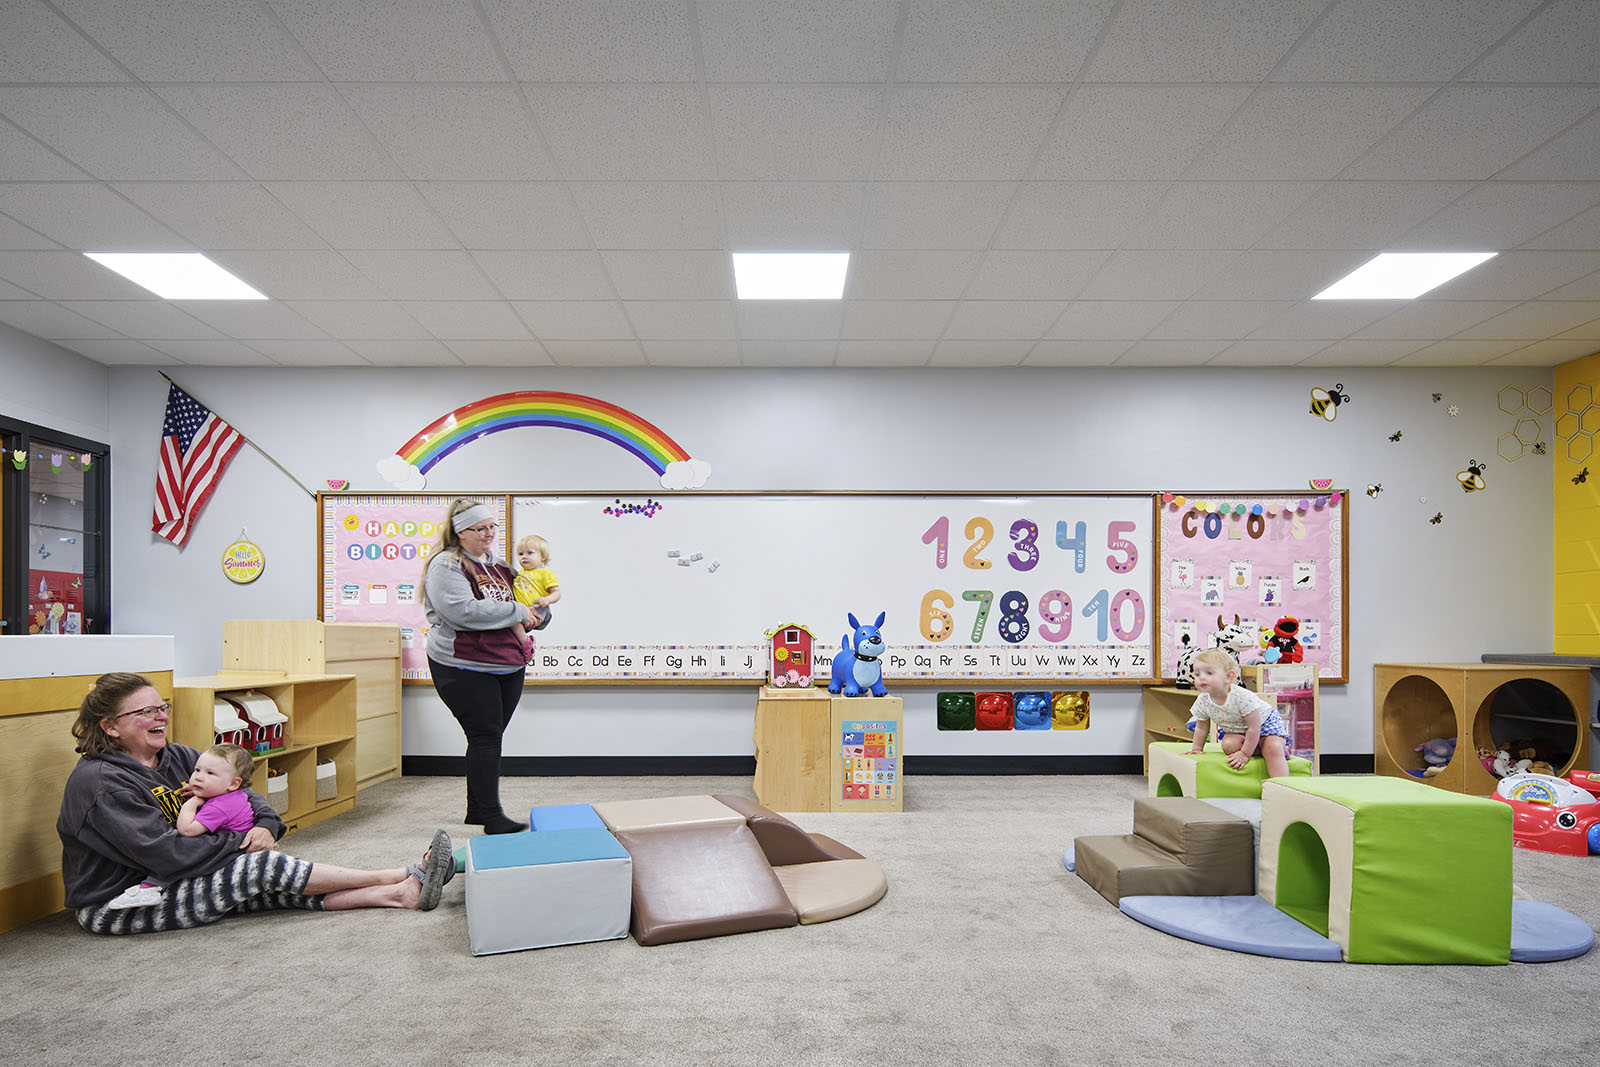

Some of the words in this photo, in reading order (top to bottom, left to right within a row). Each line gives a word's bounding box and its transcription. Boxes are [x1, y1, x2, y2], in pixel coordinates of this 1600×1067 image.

[367, 522, 443, 536] HAPP
[1182, 511, 1306, 540] COLORS
[921, 515, 950, 570] 1
[962, 516, 994, 570] 2
[1007, 518, 1040, 572] 3
[1055, 520, 1087, 574] 4
[1106, 520, 1139, 574] 5
[973, 540, 987, 553] TWO
[1112, 541, 1130, 549] FIVE
[350, 545, 431, 559] BIRTH
[1020, 543, 1037, 562] THREE
[224, 557, 259, 569] Summer
[1087, 600, 1100, 613] TEN
[919, 589, 955, 642] 6
[961, 590, 994, 643] 7
[998, 590, 1030, 643] 8
[1038, 589, 1073, 643] 9
[1081, 588, 1146, 642] 10
[928, 610, 942, 618] SIX
[1055, 611, 1071, 623] NINE
[973, 617, 984, 640] SEVEN
[1015, 622, 1028, 641] EIGHT
[543, 656, 558, 666] Bb
[567, 656, 583, 666] Cc
[592, 656, 609, 666] Dd
[618, 656, 632, 666] Ee
[643, 656, 656, 666] Ff
[666, 656, 682, 669] Gg
[691, 656, 707, 666] Hh
[743, 656, 753, 669] Jj
[814, 655, 832, 666] Mm
[890, 655, 907, 669] Pp
[914, 655, 932, 669] Qq
[939, 655, 953, 665] Rr
[964, 655, 978, 665] Ss
[989, 655, 1001, 666] Tt
[1011, 655, 1026, 666] Uu
[1035, 655, 1050, 666] Vv
[1058, 655, 1076, 665] Ww
[1082, 655, 1098, 665] Xx
[1107, 655, 1121, 668] Yy
[1131, 655, 1146, 665] Zz
[852, 722, 887, 730] Opposites
